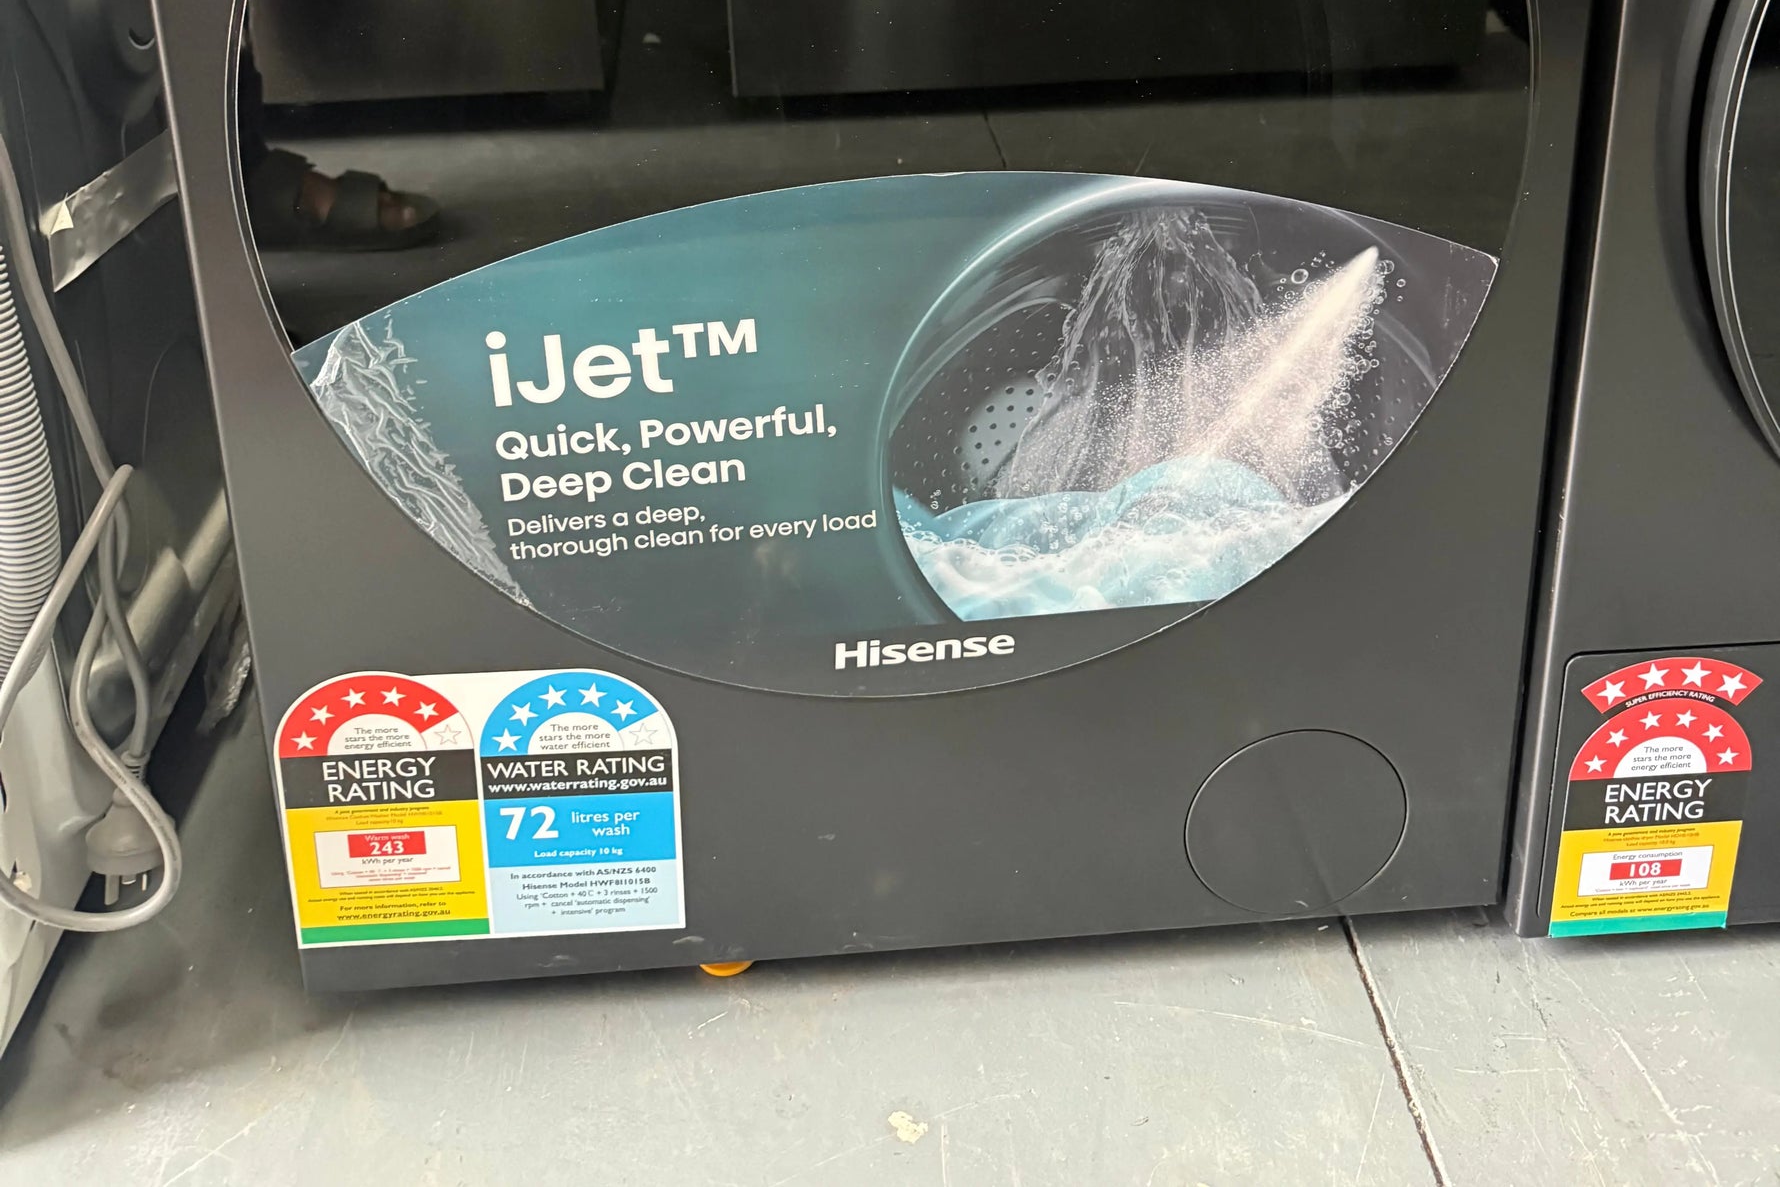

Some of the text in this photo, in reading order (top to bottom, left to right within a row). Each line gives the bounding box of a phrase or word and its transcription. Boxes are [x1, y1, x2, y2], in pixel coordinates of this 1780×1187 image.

[495, 403, 837, 461] Quick, Powerful,
[500, 458, 746, 503] Deep Clean
[507, 504, 706, 537] Delivers a deep,
[509, 509, 877, 560] thorough clean for every load
[834, 633, 1016, 670] Hisense
[1625, 695, 1648, 708] SUPER
[1688, 690, 1716, 703] RATING
[354, 727, 372, 735] The
[550, 724, 569, 732] The
[369, 734, 384, 742] the
[539, 732, 611, 742] stars the more
[344, 741, 412, 751] energy efficient
[540, 741, 611, 751] water efficient
[1644, 745, 1684, 754] The more
[1633, 755, 1652, 763] stars
[1654, 753, 1668, 761] the
[322, 756, 436, 781] ENERGY
[487, 755, 665, 780] WATER RATING
[1631, 761, 1691, 772] energy efficient
[327, 779, 436, 803] RATING
[488, 776, 668, 794] www.waterrating.gov.au
[1604, 778, 1713, 803] ENERGY
[571, 811, 640, 825] litres per
[1604, 801, 1705, 824] RATING
[499, 805, 559, 841] 72
[592, 824, 630, 837] wash
[369, 841, 405, 855] 243
[534, 847, 623, 858] Load capacity 10 kg
[1612, 850, 1683, 861] Energy consumption
[510, 866, 656, 880] In accordance with AS/NZS 6400
[1629, 862, 1662, 878] 108
[522, 882, 558, 890] Hisense
[560, 880, 588, 889] Model
[516, 893, 538, 901] Using
[551, 899, 573, 907] cancel
[595, 907, 626, 915] program
